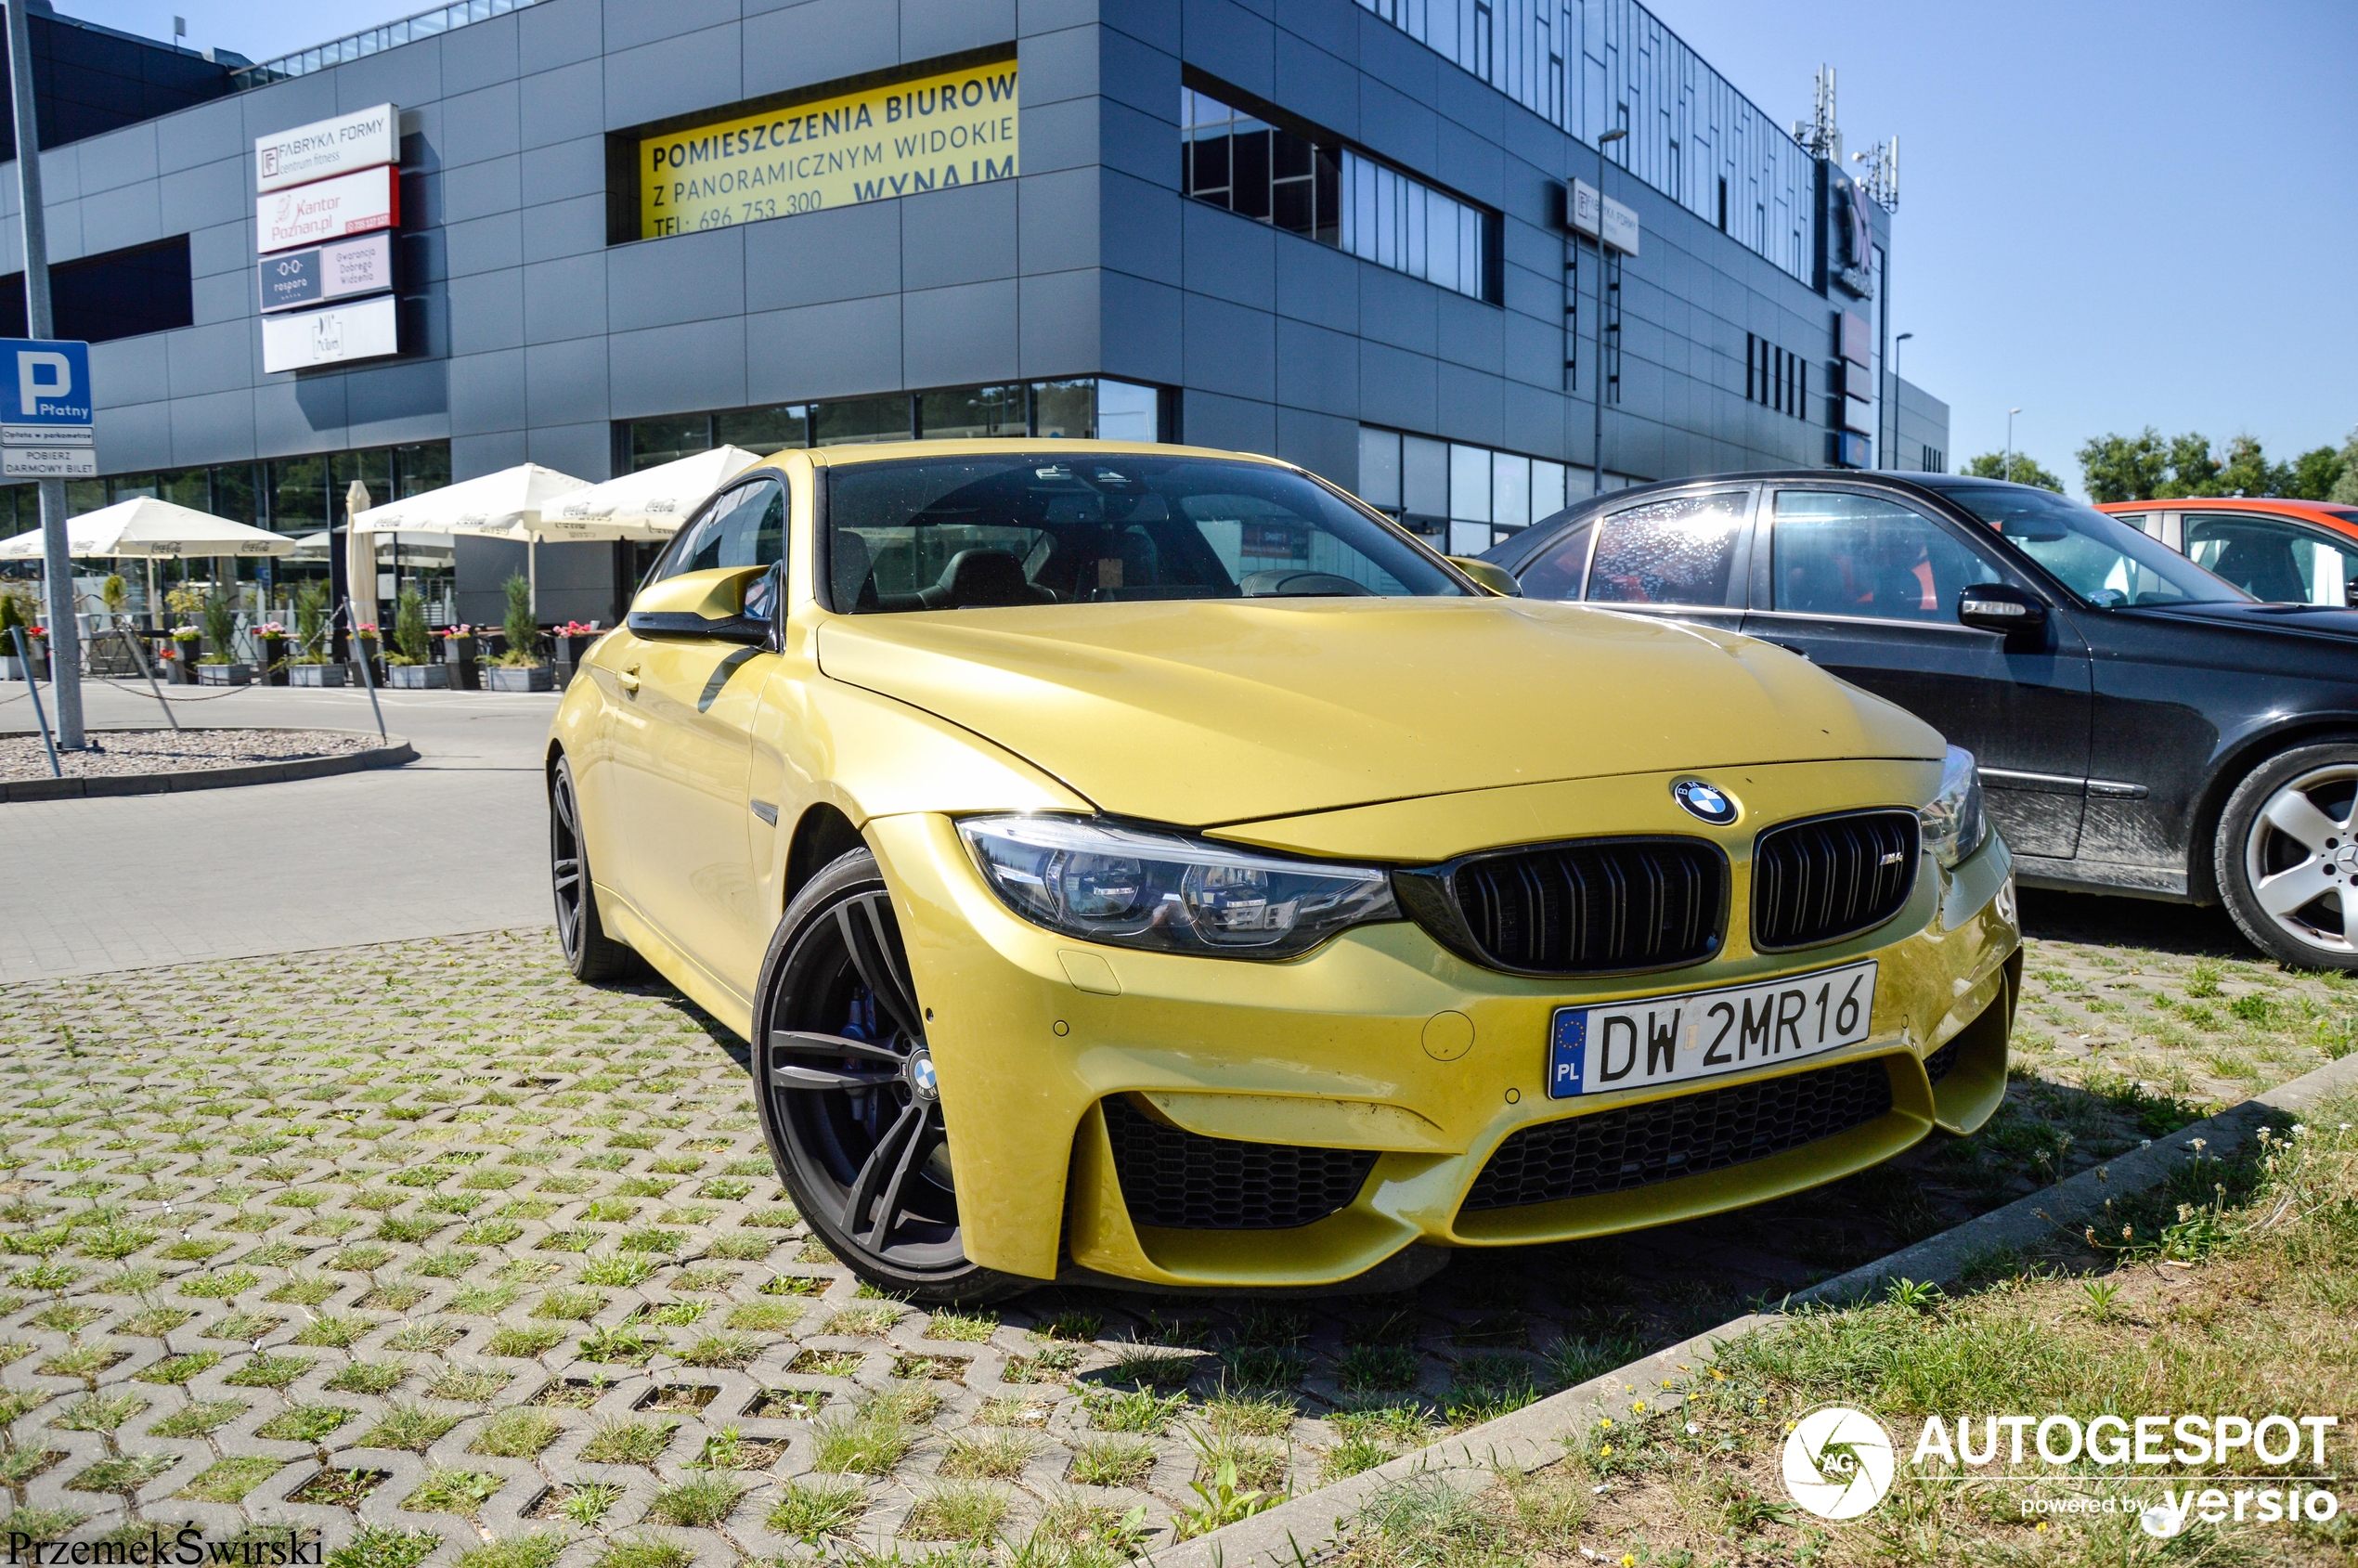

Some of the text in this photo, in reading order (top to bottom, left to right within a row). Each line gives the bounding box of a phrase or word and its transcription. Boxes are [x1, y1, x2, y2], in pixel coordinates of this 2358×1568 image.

[654, 71, 1017, 172] POMIESZCZENIA BIUROW
[279, 118, 384, 159] FABRYKA FORMY
[279, 151, 340, 175] centrum fitness
[654, 117, 1014, 207] Z PANORAMICZNYM WIDOKIE
[296, 196, 341, 217] Kantor
[699, 207, 732, 231] 696
[743, 199, 776, 223] 753
[786, 189, 822, 215] 300
[336, 247, 376, 263] Gwarancja
[340, 260, 373, 274] Dobrego
[17, 350, 71, 415] P
[39, 403, 89, 420] Płatny
[44, 432, 92, 440] parkometrze
[26, 451, 71, 460] POBIERZ
[6, 464, 94, 473] DARMOWY BILET
[1678, 782, 1719, 796] BMW
[1600, 974, 1865, 1083] DW 2MR16
[1557, 1063, 1579, 1082] PL
